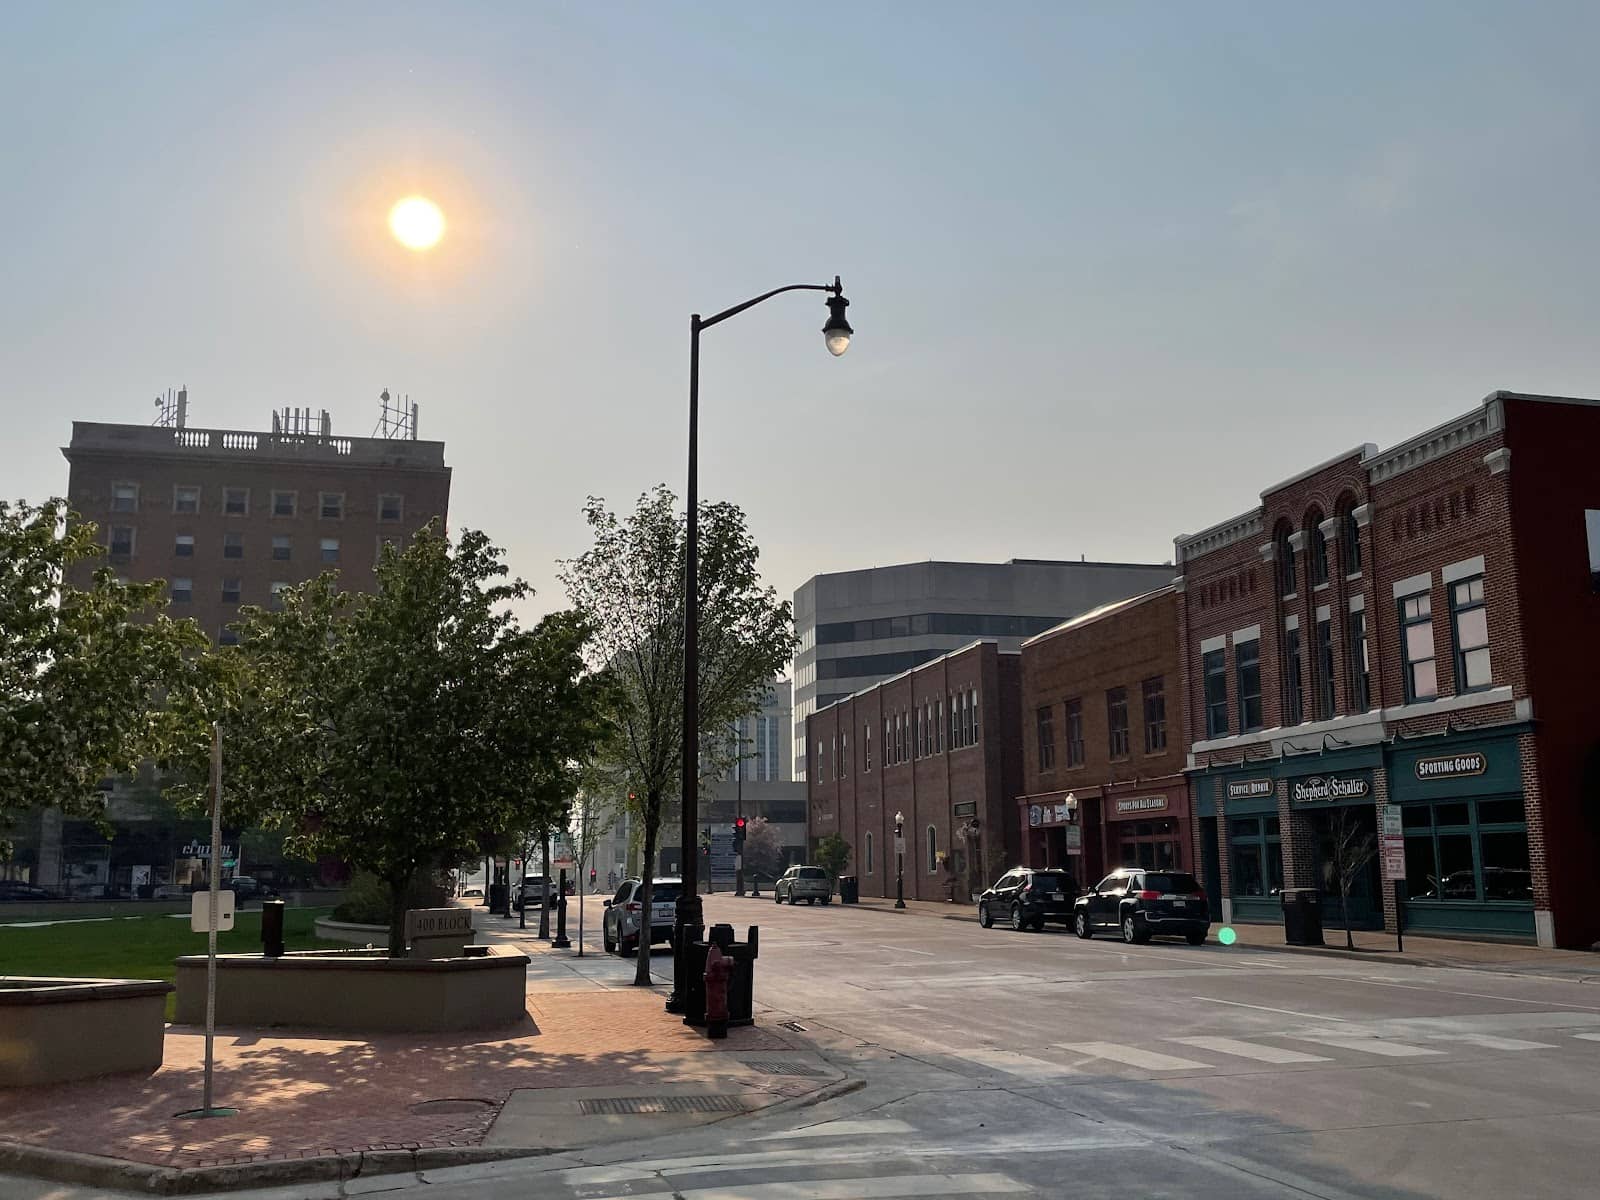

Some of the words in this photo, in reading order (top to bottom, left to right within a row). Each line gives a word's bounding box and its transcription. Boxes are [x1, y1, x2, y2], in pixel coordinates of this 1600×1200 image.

[1419, 760, 1454, 775] SPORTING
[1455, 757, 1480, 771] GOODS
[1230, 784, 1249, 796] SERVICE
[1295, 783, 1329, 801] Shepherd
[1332, 778, 1364, 796] Schaller
[417, 918, 435, 930] 400
[438, 916, 472, 929] BLOCK
